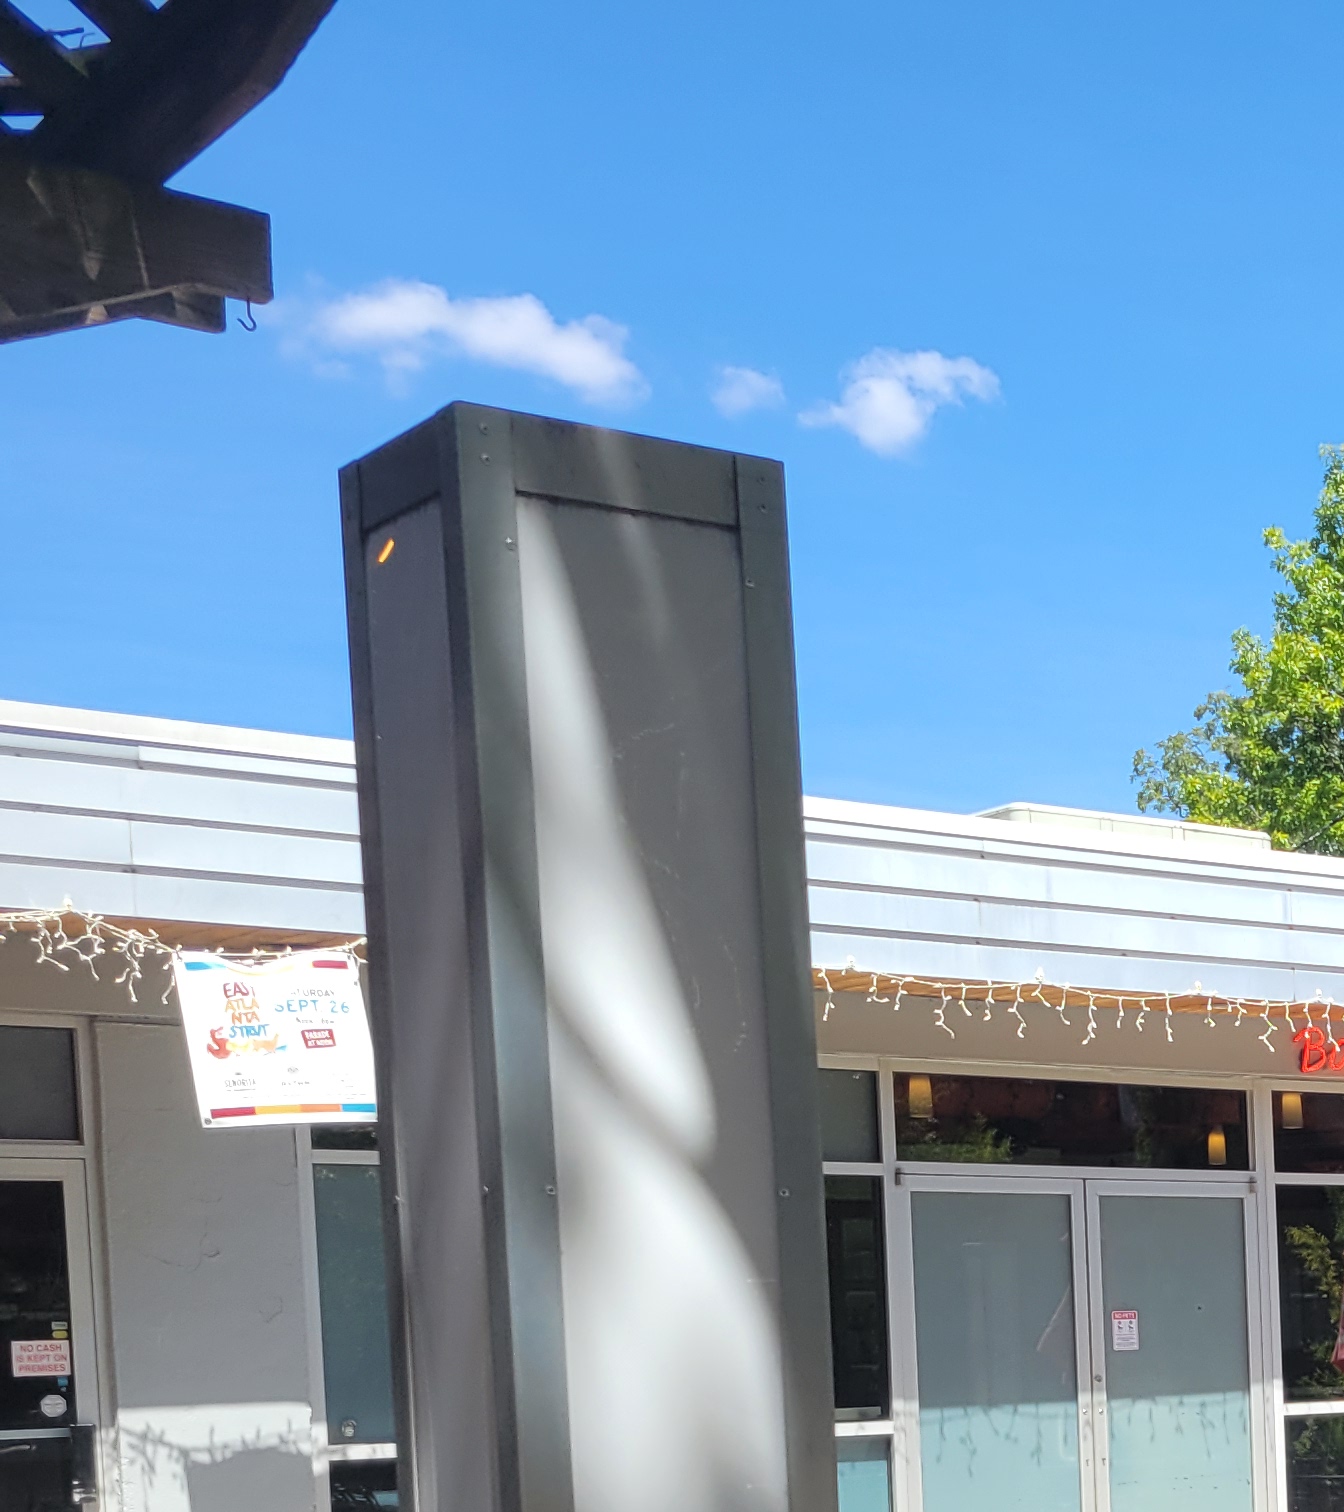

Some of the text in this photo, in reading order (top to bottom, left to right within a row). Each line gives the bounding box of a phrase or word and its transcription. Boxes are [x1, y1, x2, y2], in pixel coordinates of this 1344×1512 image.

[330, 1000, 350, 1013] 26
[36, 1343, 62, 1352] CASH
[27, 1355, 51, 1363] KEPT
[18, 1364, 66, 1372] PREMISES
